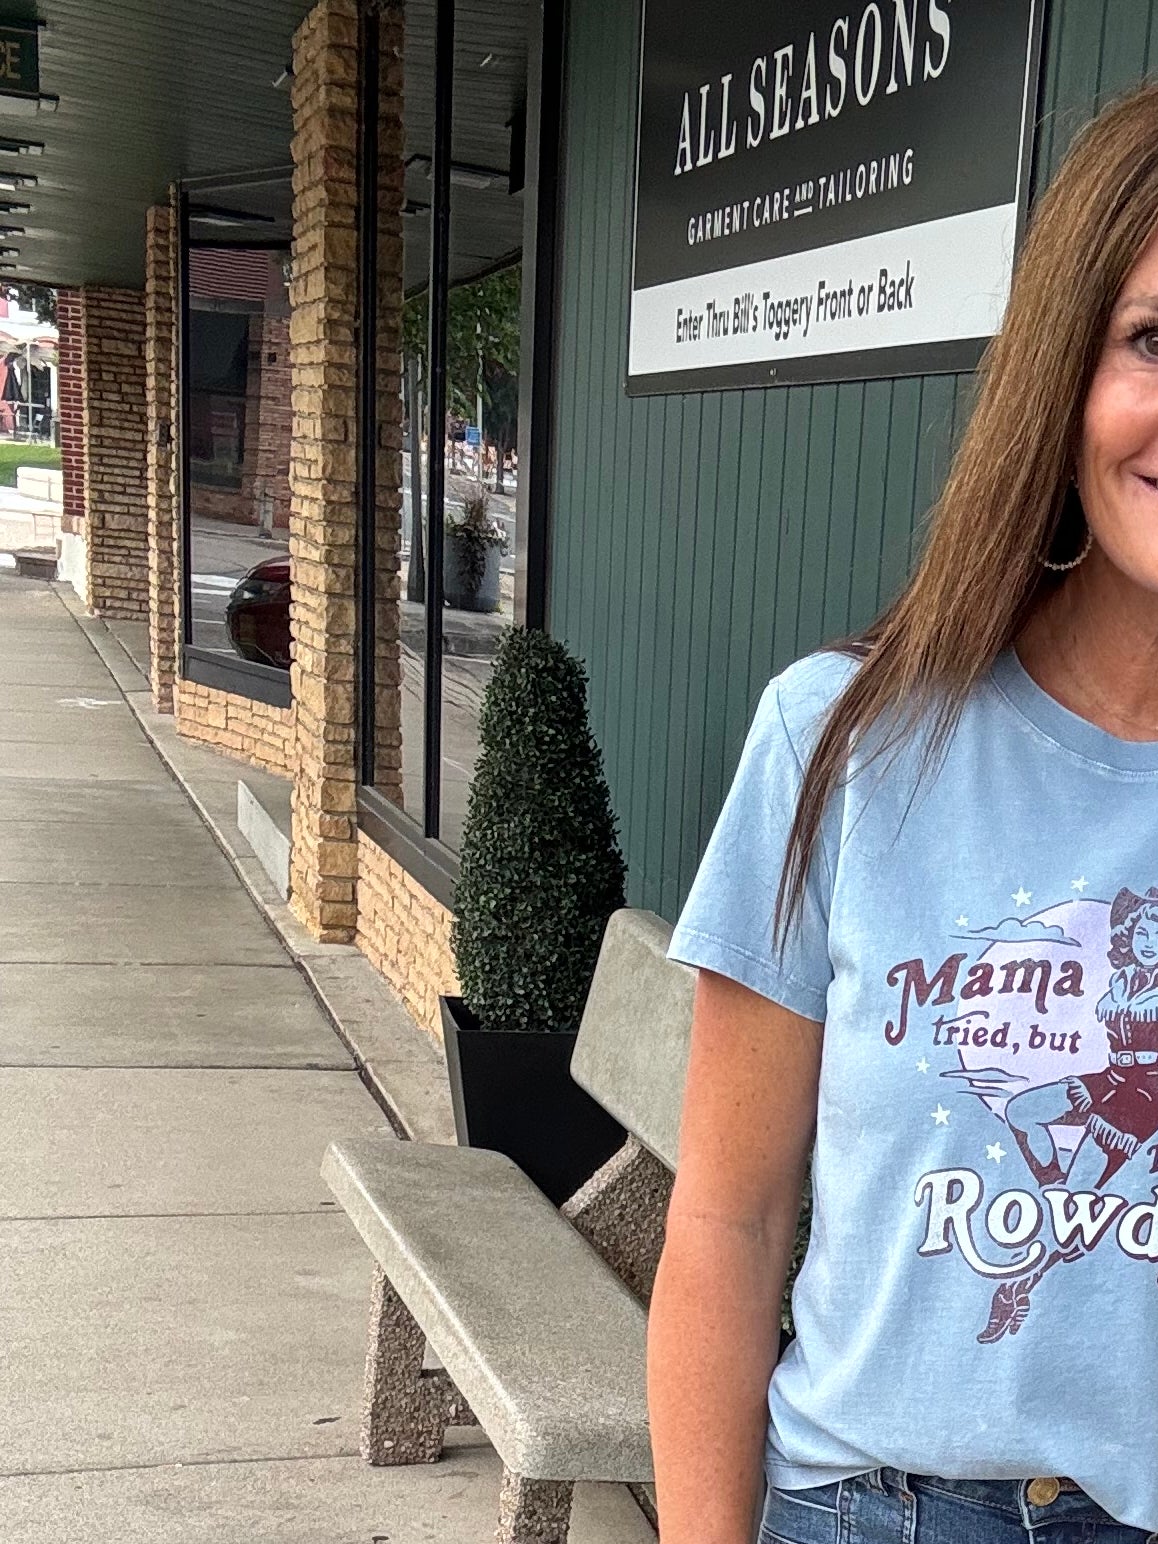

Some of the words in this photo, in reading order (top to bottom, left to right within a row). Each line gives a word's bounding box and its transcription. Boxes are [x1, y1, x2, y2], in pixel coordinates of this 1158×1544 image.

[674, 73, 737, 176] ALL
[746, 0, 951, 149] SEASONS
[687, 201, 750, 245] GARMENT
[753, 188, 790, 228] CARE
[794, 180, 814, 203] AND
[818, 148, 914, 210] TAILORING
[676, 308, 703, 343] Enter
[706, 299, 730, 339] Thru
[732, 291, 758, 335] Bill's
[762, 291, 813, 341] Toggery
[816, 279, 854, 322] Front
[857, 281, 874, 317] or
[876, 260, 915, 313] Back
[884, 952, 1085, 1046] Mama
[932, 1011, 1021, 1054] tried,
[1027, 1026, 1083, 1053] but
